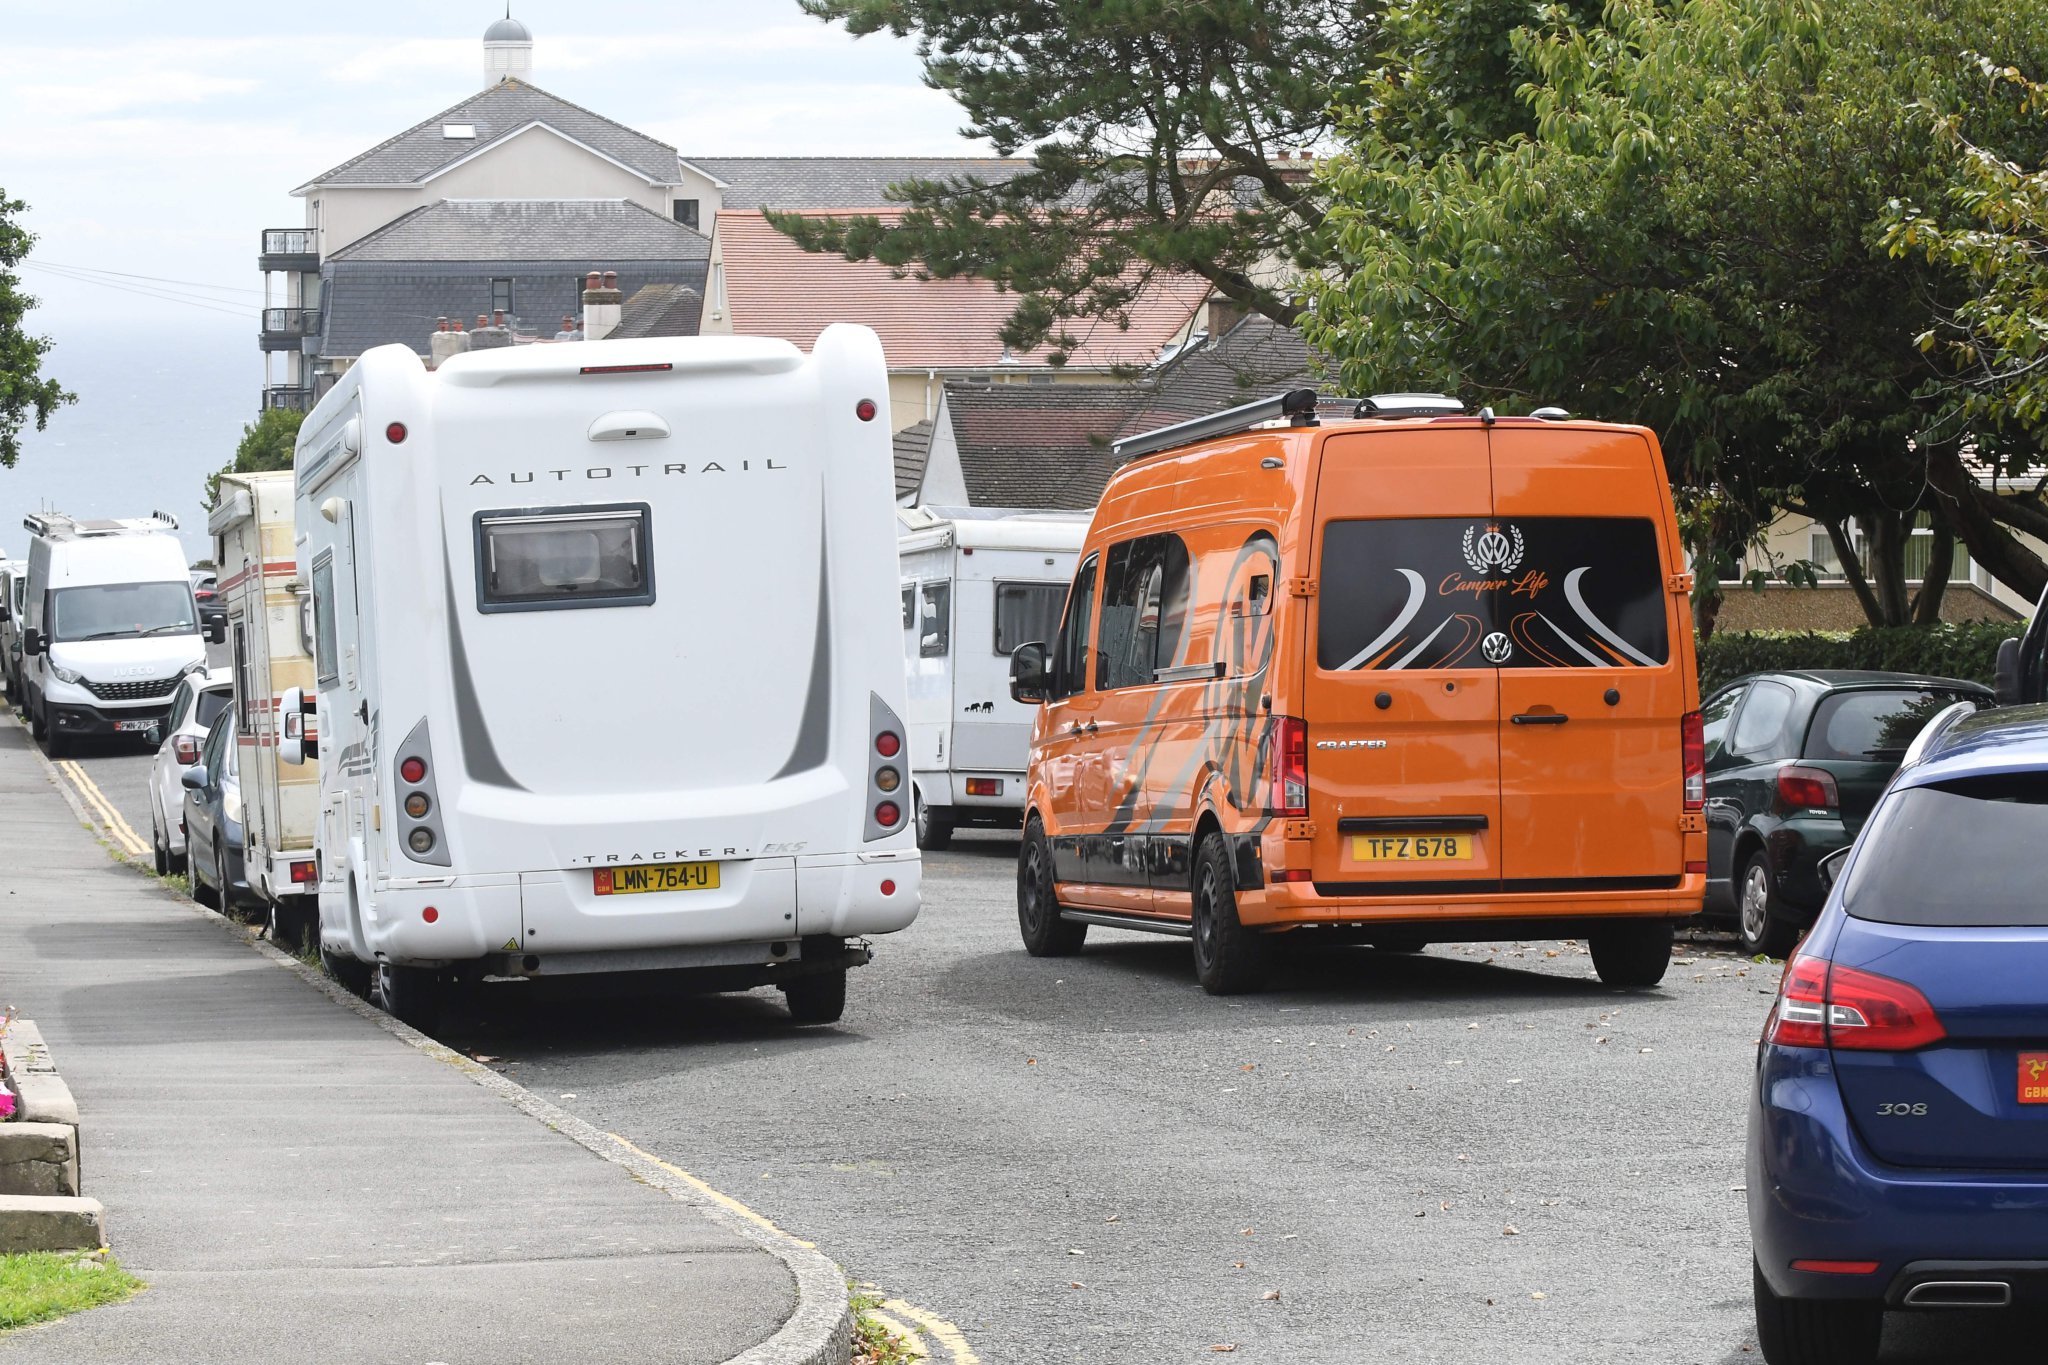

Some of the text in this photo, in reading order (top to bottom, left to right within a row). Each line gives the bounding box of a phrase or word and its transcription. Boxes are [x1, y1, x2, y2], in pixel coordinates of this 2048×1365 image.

[469, 458, 787, 485] AUTOTRAIL
[1439, 569, 1549, 600] Camper Life
[113, 665, 155, 677] IVECO
[1316, 740, 1387, 749] CRAFTER
[1368, 838, 1457, 858] TFZ 678
[612, 866, 708, 891] LMN-764-U
[1876, 1103, 1928, 1116] 308
